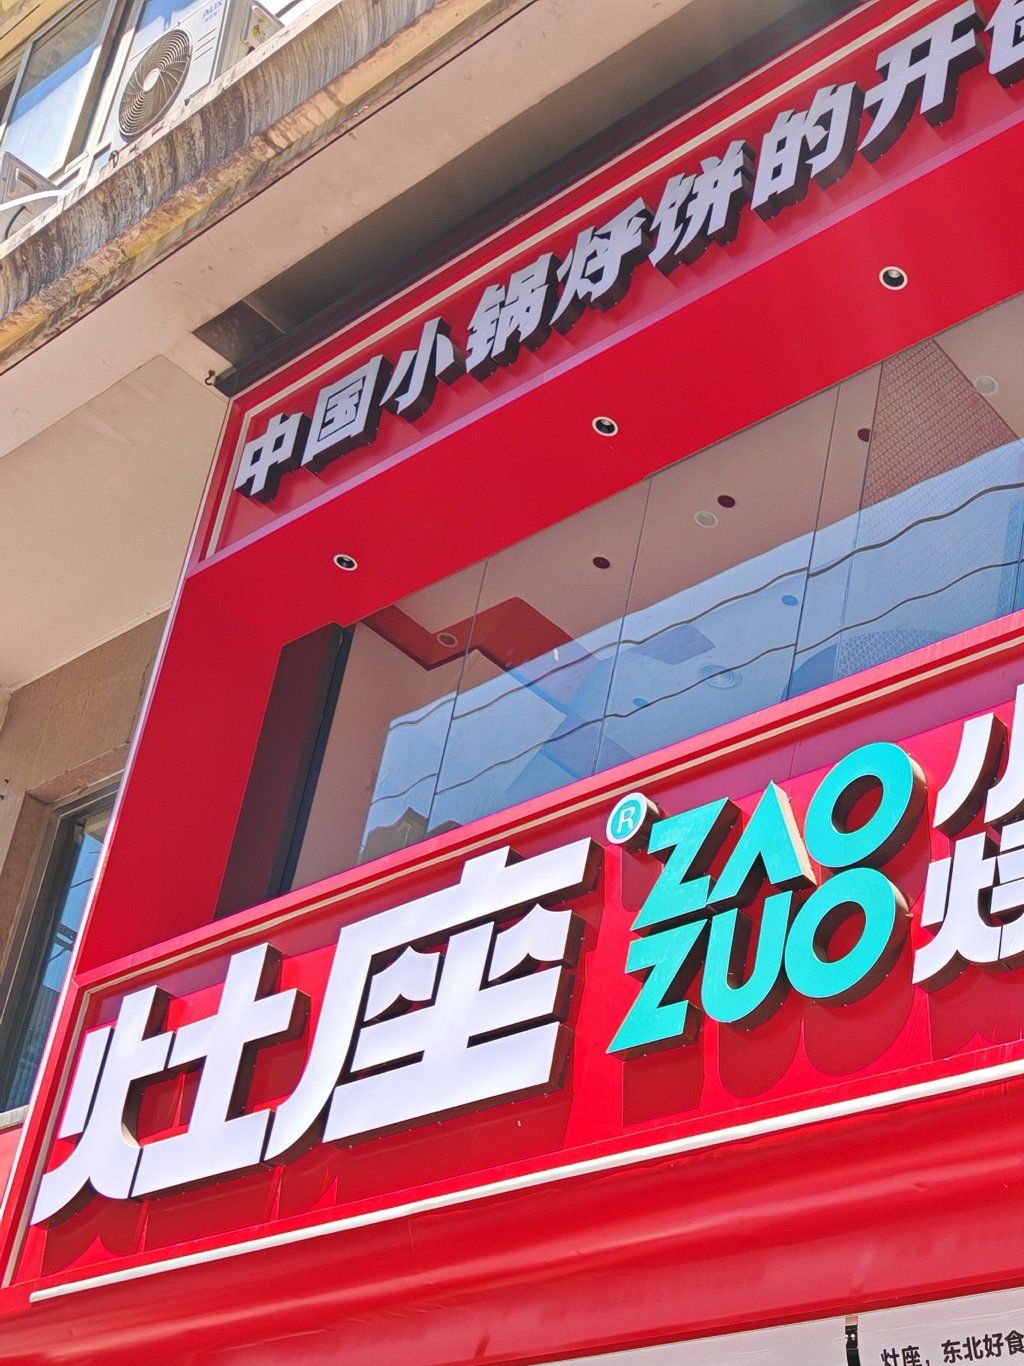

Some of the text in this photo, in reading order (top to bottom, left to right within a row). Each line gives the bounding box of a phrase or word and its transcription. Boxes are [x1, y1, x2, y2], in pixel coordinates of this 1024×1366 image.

[631, 742, 914, 930] ZAO
[31, 836, 593, 1226] 灶座
[608, 867, 909, 1053] ZUO
